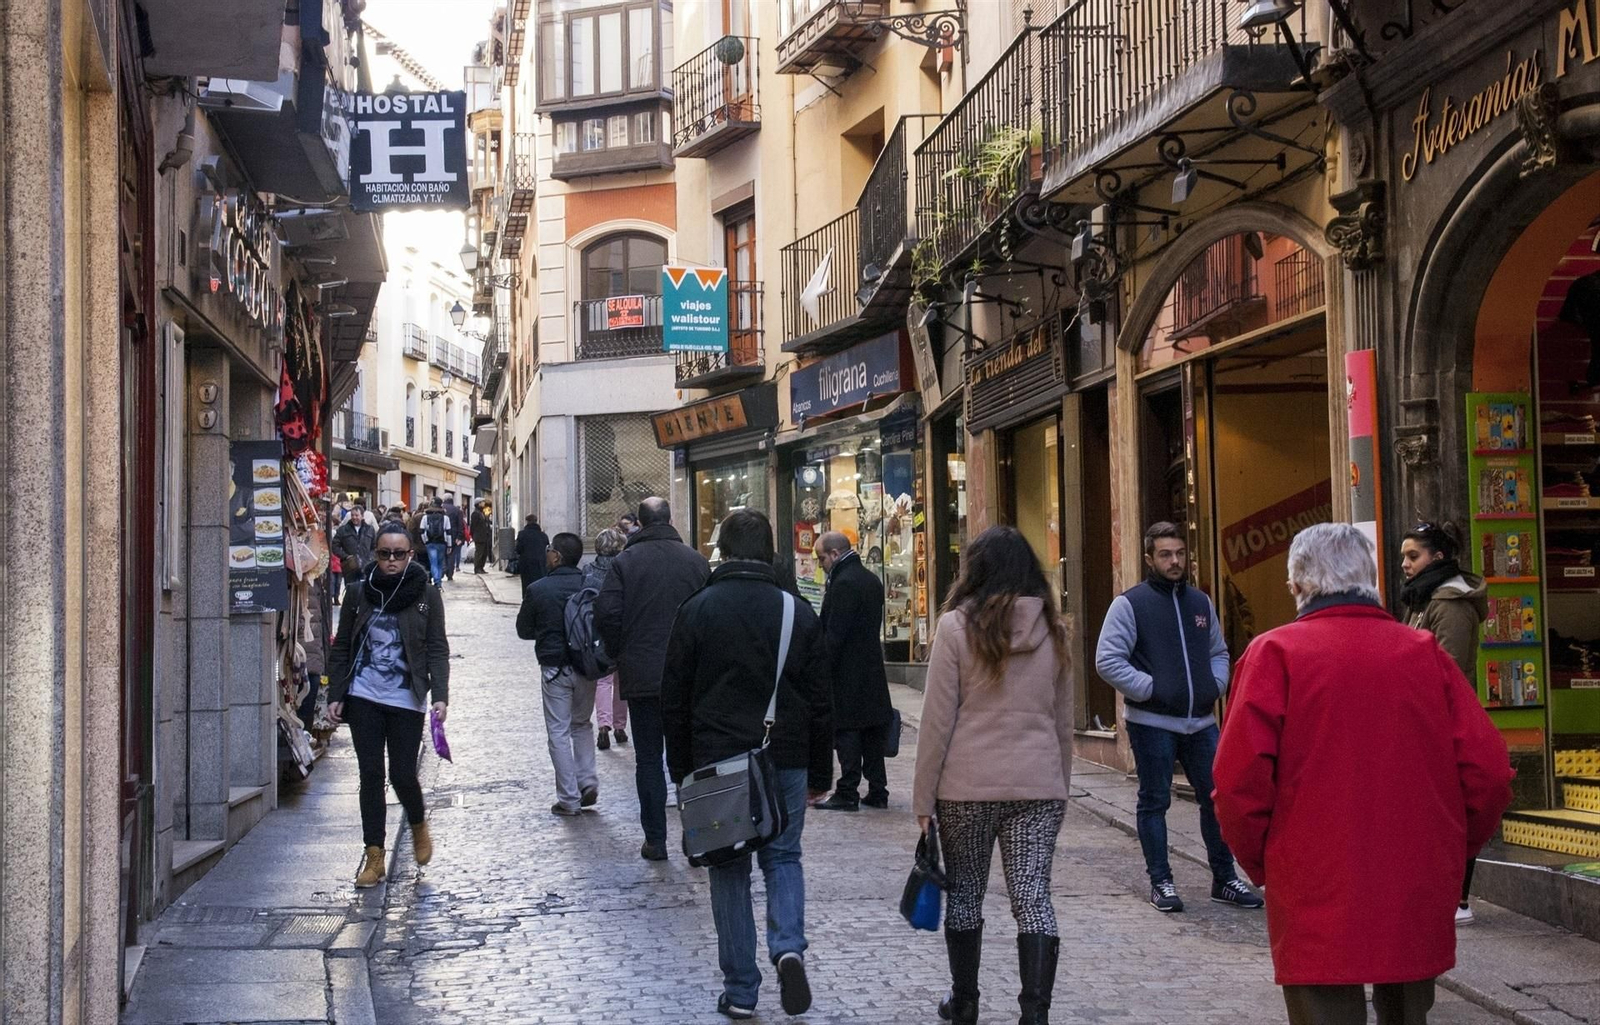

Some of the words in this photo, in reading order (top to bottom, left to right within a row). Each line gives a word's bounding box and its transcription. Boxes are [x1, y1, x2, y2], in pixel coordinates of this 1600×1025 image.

[1402, 49, 1541, 181] Artesanías
[1556, 0, 1600, 78] M
[357, 94, 454, 114] HOSTAL
[358, 120, 458, 183] H
[365, 183, 410, 193] HABITACION
[411, 183, 427, 193] CON
[428, 181, 450, 193] BAÑO
[372, 194, 422, 204] CLIMATIZADA
[423, 194, 429, 203] Y
[430, 194, 444, 203] T.V.
[608, 299, 615, 312] SE
[616, 297, 642, 311] ALQUILA
[680, 300, 712, 312] viajes
[671, 314, 721, 324] walistour
[969, 366, 982, 387] La
[985, 334, 1023, 380] tienda
[1026, 324, 1044, 358] del
[793, 399, 812, 414] Abanicos
[818, 361, 868, 406] filigrana
